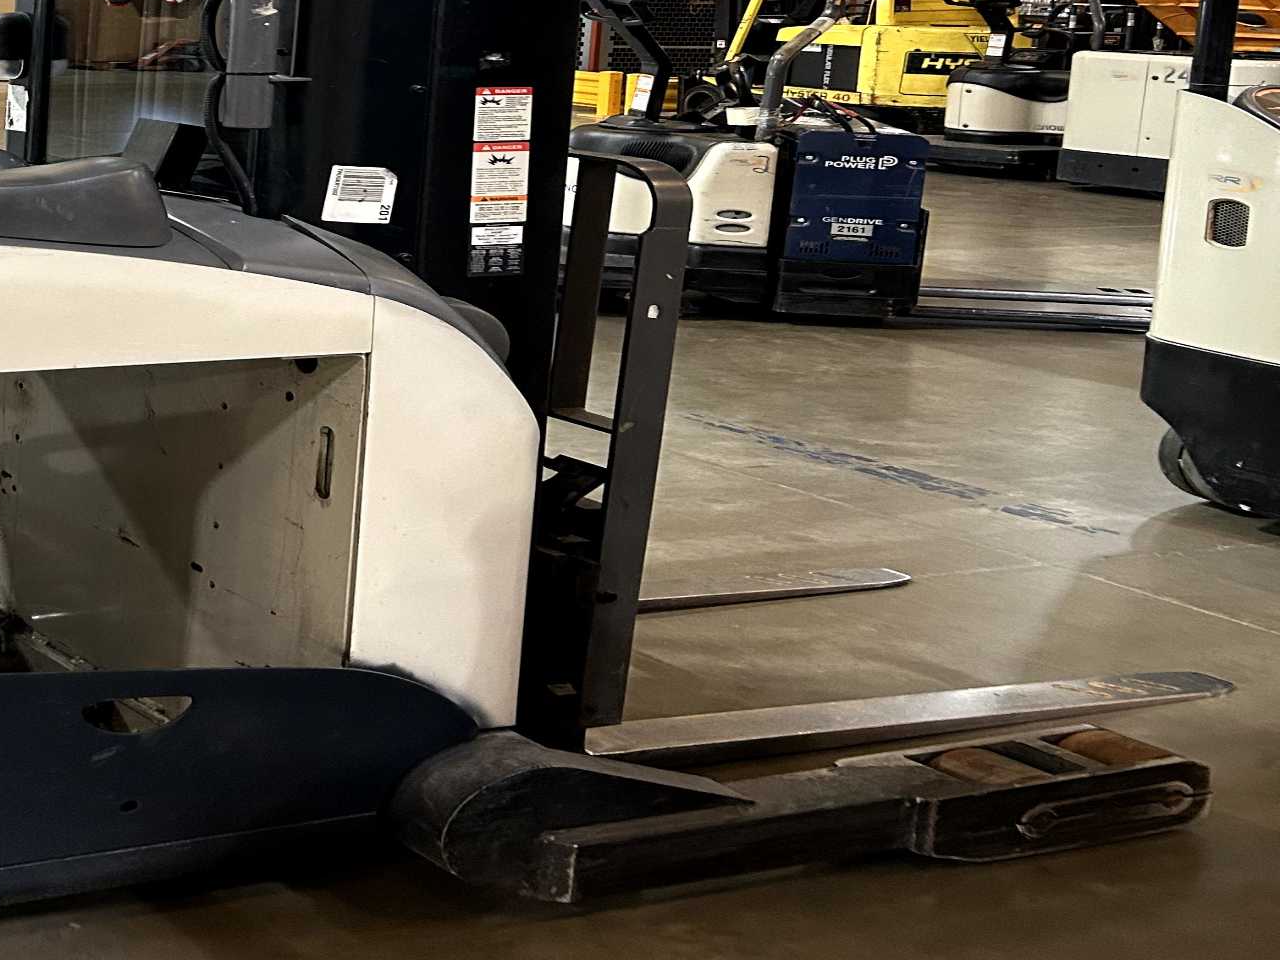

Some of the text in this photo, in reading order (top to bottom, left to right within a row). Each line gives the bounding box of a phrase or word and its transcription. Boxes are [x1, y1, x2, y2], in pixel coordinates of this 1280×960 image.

[832, 93, 851, 102] 40
[841, 155, 876, 164] PLUG
[824, 160, 875, 170] POWER
[822, 216, 884, 225] GENDRIVE
[836, 225, 867, 234] 2161
